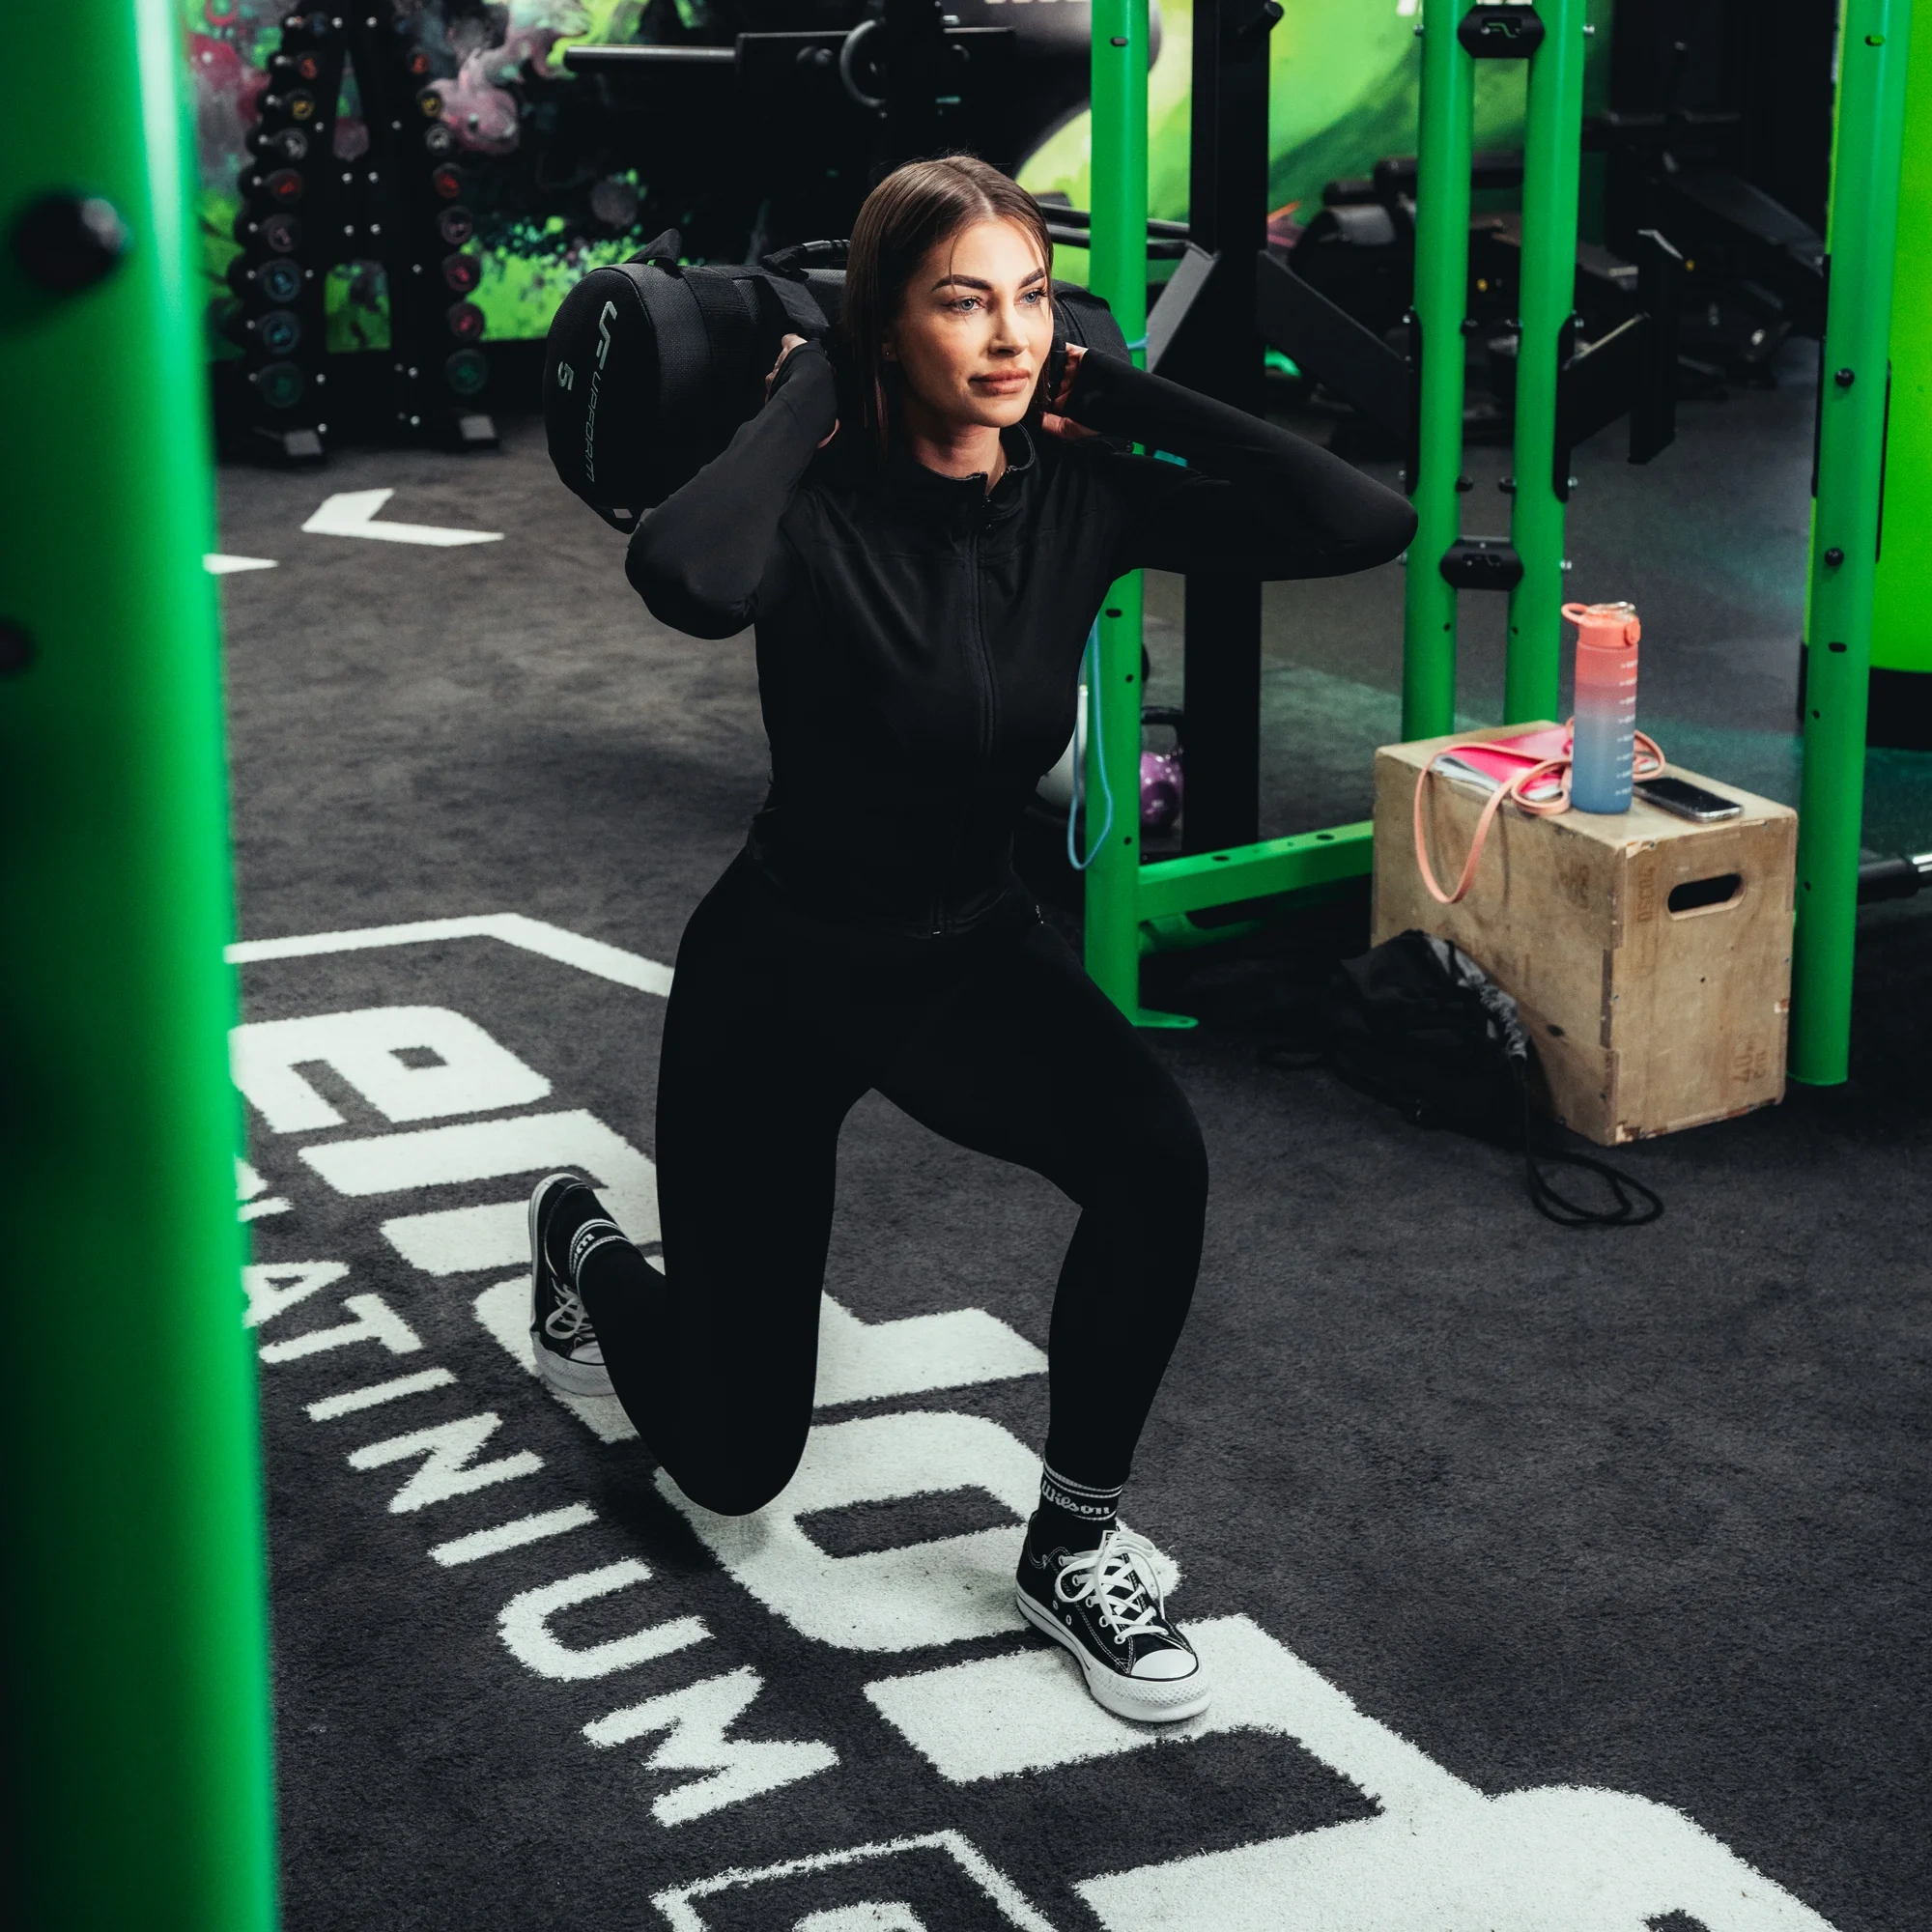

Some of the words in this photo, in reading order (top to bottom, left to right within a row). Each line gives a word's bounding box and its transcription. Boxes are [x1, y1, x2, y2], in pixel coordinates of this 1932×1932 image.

[557, 360, 574, 390] 5
[584, 371, 601, 482] UPFORM
[234, 1152, 840, 1828] ATINIUM
